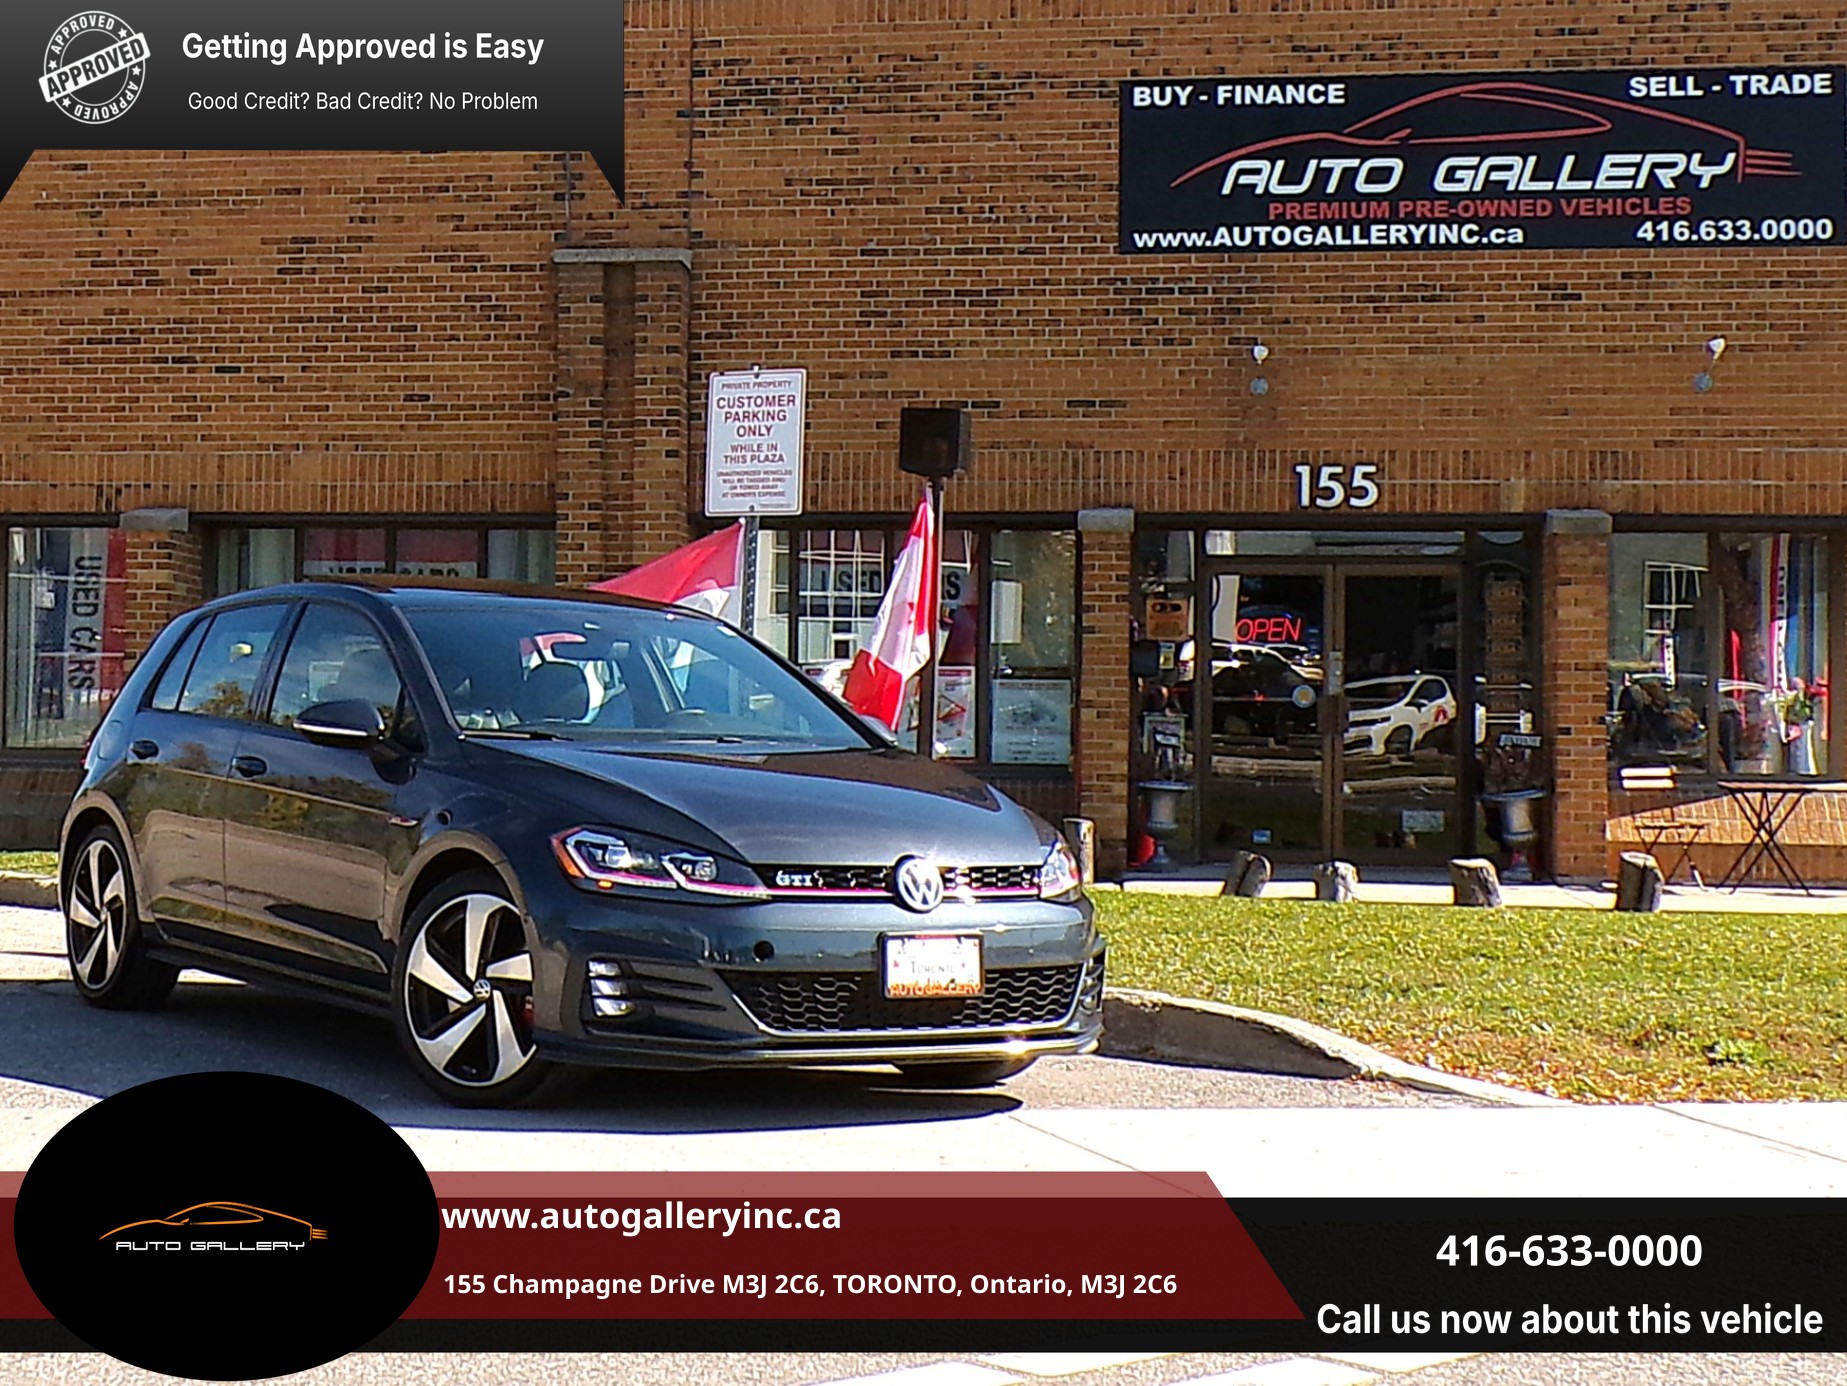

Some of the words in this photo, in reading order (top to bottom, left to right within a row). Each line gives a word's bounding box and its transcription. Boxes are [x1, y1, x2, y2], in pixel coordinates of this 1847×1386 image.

[1132, 86, 1194, 107] BUY
[1216, 83, 1346, 106] FINANCE
[1628, 76, 1704, 98] SELL
[1729, 73, 1833, 96] TRADE
[1221, 157, 1404, 195] AUTO
[1432, 152, 1737, 193] GALLERY
[1268, 201, 1391, 221] PREMIUM
[1399, 198, 1553, 218] PRE-OWNED
[1560, 196, 1692, 217] VEHICLES
[1133, 223, 1524, 248] www.AUTOGALLERYINC.ca
[1636, 218, 1833, 242] 416.633.0000
[721, 382, 751, 390] PRIVATE
[753, 380, 792, 389] PROPERTY
[716, 394, 796, 410] CUSTOMER
[724, 409, 788, 423] PARKING
[736, 424, 773, 438] ONLY
[723, 454, 748, 464] THIS
[750, 453, 785, 463] PLAZA
[730, 442, 764, 453] WHILE
[767, 442, 778, 452] IN
[1295, 464, 1379, 508] 155
[71, 556, 103, 617] USED
[1235, 617, 1301, 642] OPEN
[68, 626, 101, 690] CARS
[775, 870, 813, 887] GTI
